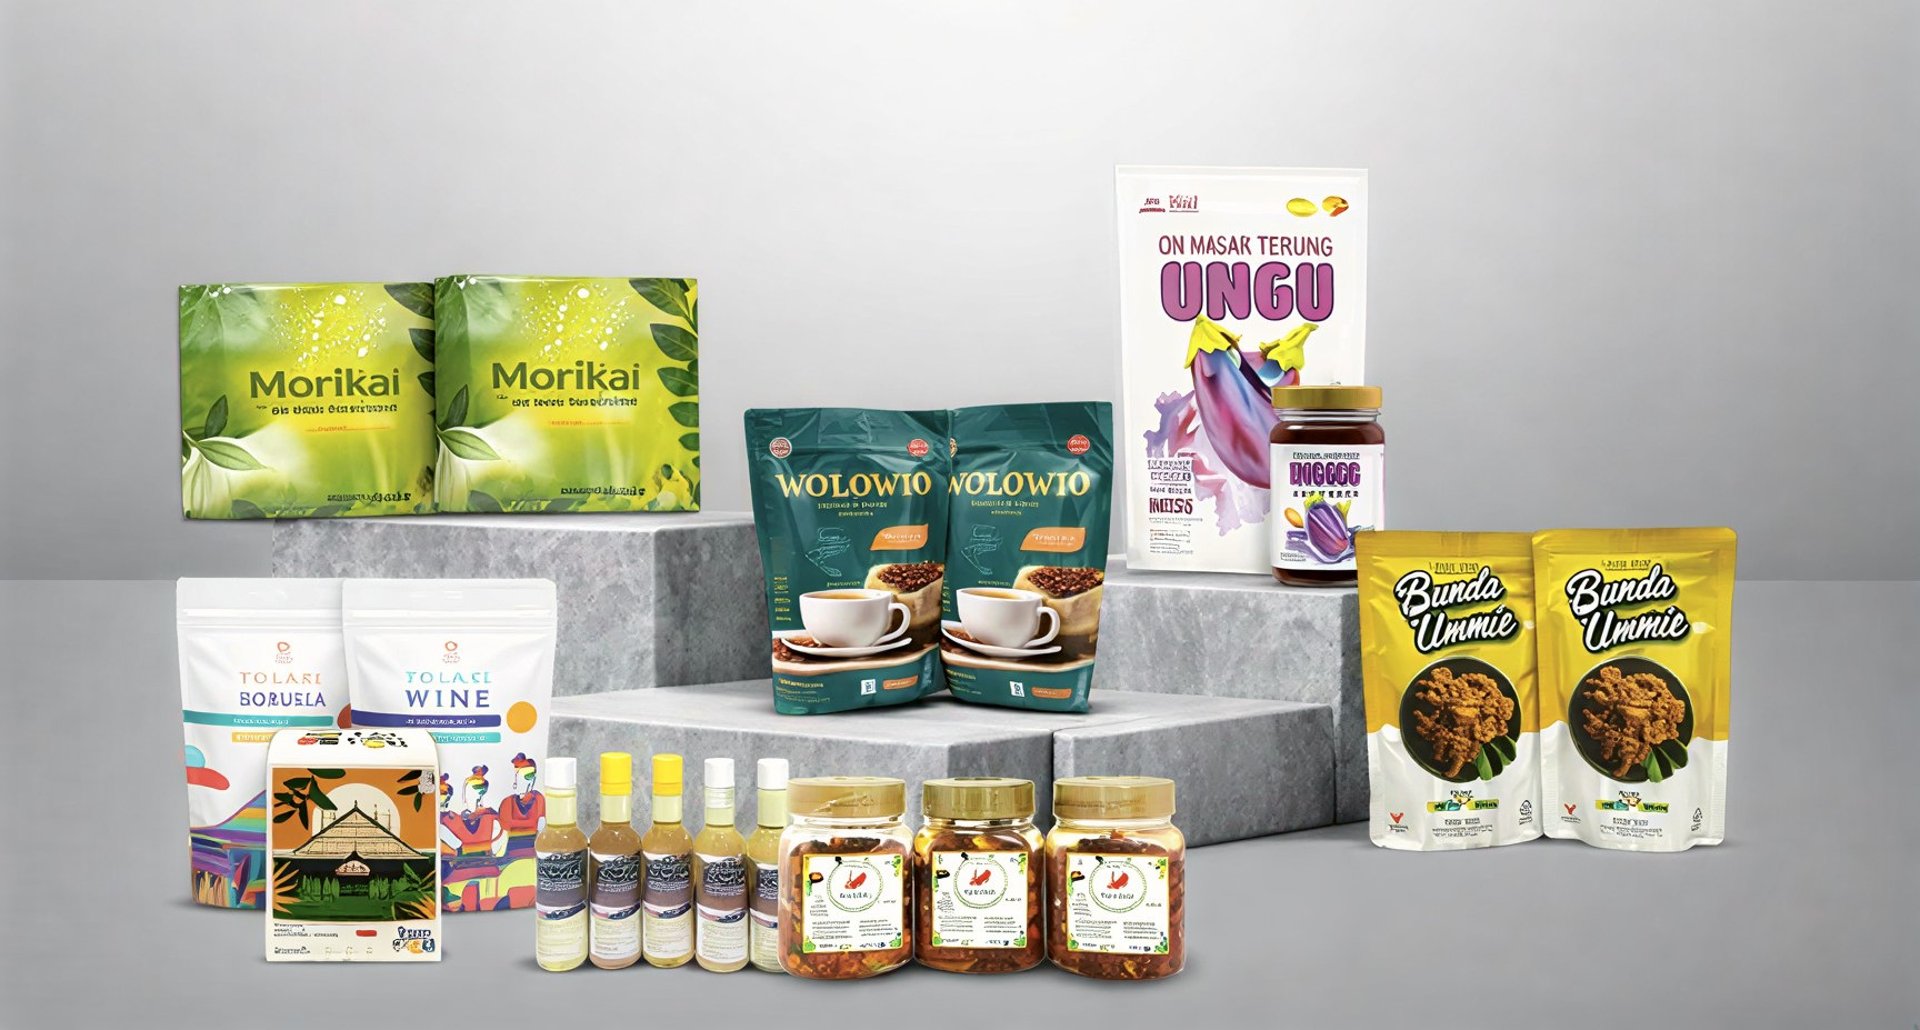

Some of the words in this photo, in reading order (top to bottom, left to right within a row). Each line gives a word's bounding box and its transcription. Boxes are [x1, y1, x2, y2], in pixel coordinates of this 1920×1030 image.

[1158, 234, 1185, 255] ON
[1257, 236, 1333, 257] TERUNG
[1160, 261, 1334, 322] UNGU
[249, 367, 401, 399] Morikai
[491, 360, 641, 391] Morikai
[775, 471, 932, 499] WOLOWIO
[1394, 565, 1505, 617] Bunda
[1566, 564, 1676, 616] Bunda
[1411, 603, 1517, 652] Ummie
[1581, 605, 1689, 651] Ummie
[405, 689, 490, 708] WINE
